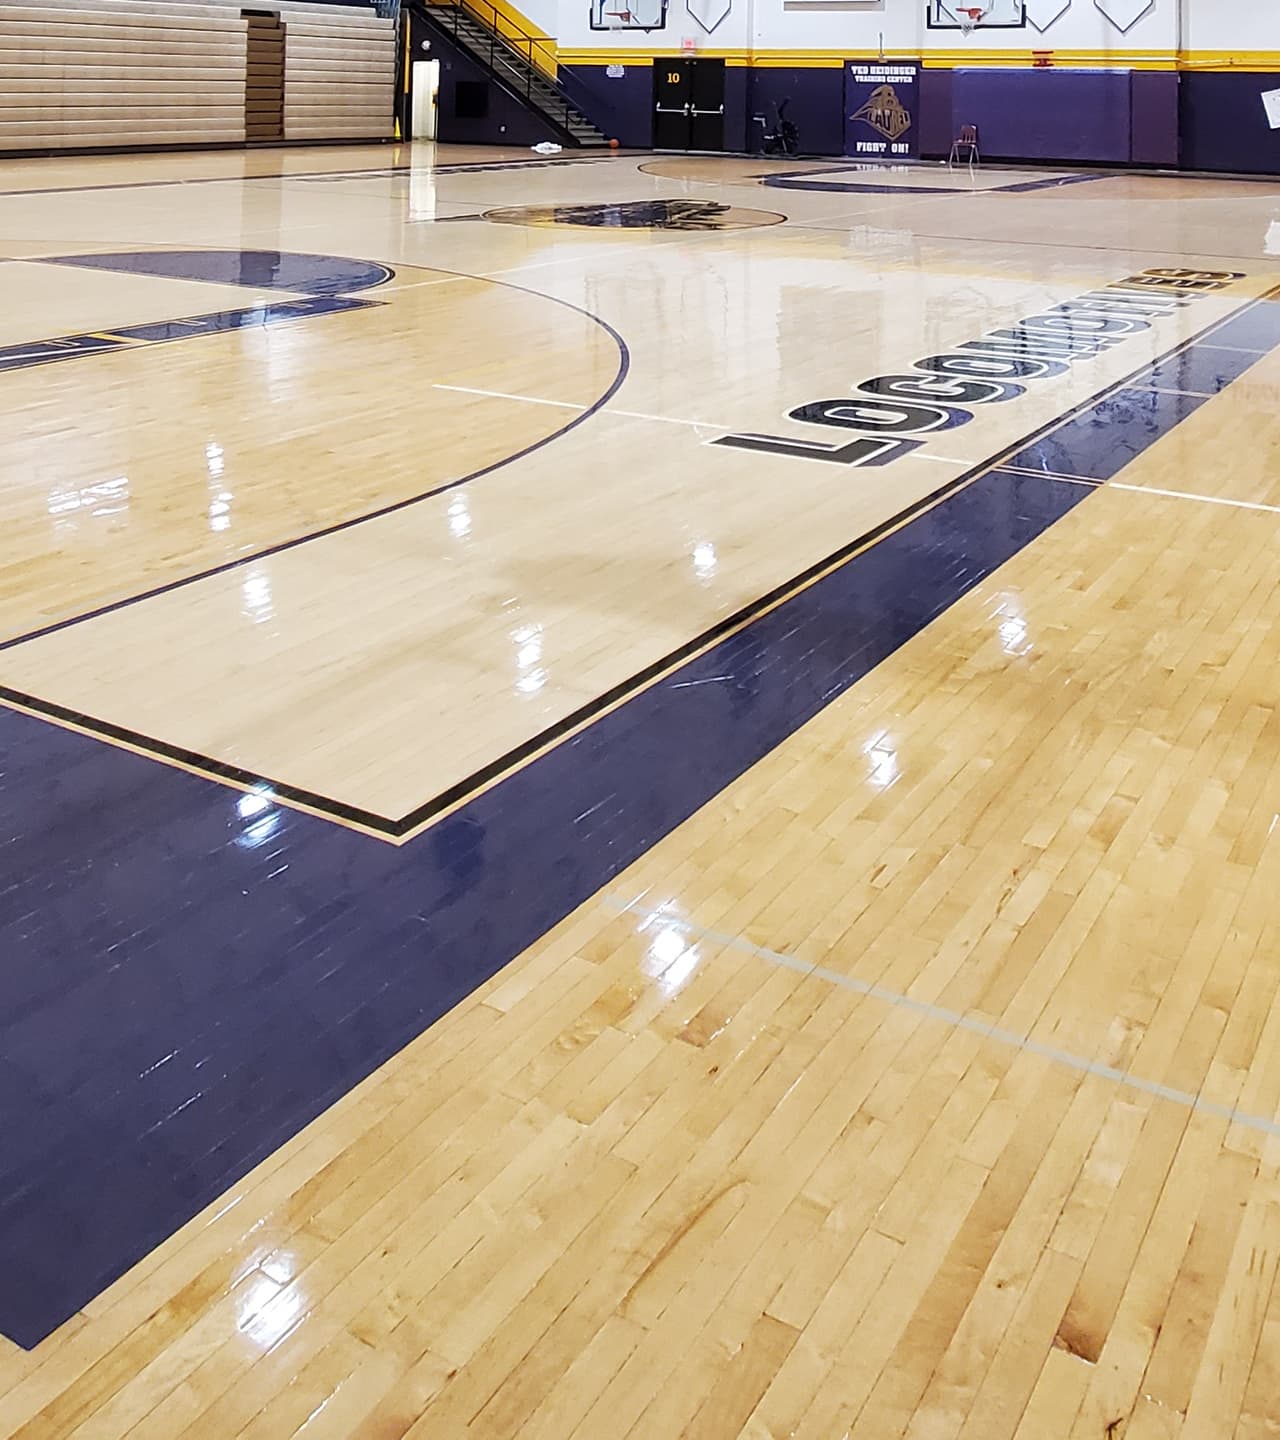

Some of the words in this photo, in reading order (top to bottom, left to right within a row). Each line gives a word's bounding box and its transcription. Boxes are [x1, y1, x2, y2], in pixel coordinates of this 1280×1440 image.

[667, 72, 680, 83] 10
[856, 142, 886, 152] FIGHT
[891, 143, 909, 153] ON!
[702, 266, 1247, 468] LOCOMOTIVES
